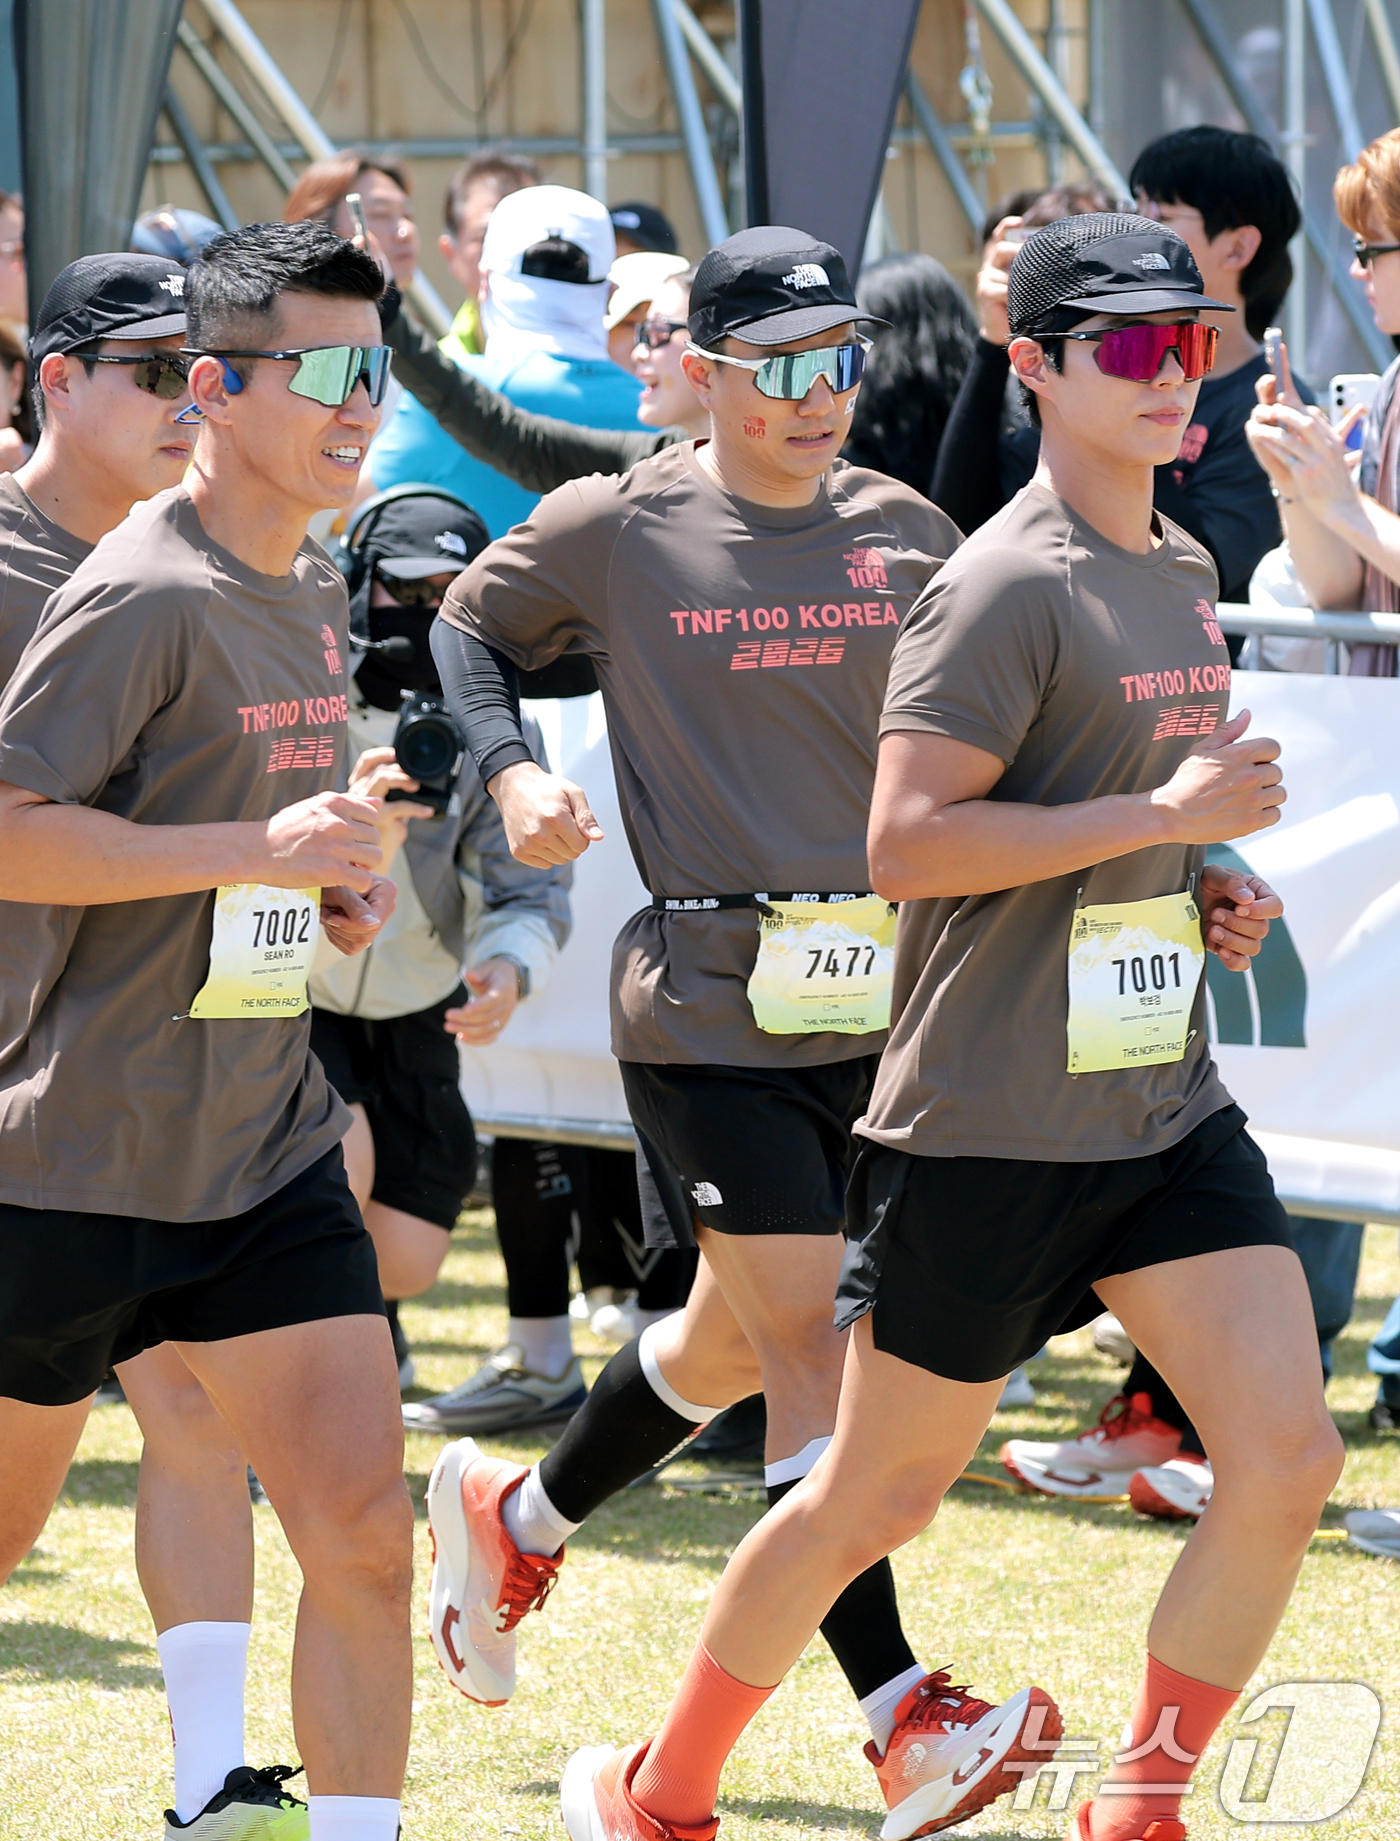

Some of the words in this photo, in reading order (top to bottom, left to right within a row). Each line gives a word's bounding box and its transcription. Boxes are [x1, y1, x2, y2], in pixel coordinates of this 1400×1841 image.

[792, 264, 813, 274] THE
[782, 270, 816, 286] NORTH
[794, 279, 817, 290] FACE
[846, 567, 888, 588] 100
[670, 606, 789, 635] TNF100
[799, 602, 899, 628] KOREA
[730, 637, 846, 671] 2026
[1119, 669, 1185, 703] TNF100
[237, 700, 300, 734] TNF100
[791, 893, 820, 903] NEO
[253, 906, 310, 948] 7002
[765, 919, 783, 930] 100
[264, 950, 283, 961] SEAN
[284, 949, 295, 960] RO
[805, 945, 876, 979] 7477
[1112, 952, 1181, 995] 7001
[241, 999, 255, 1008] THE
[256, 998, 280, 1008] NORTH
[1139, 994, 1161, 1007] 박보검
[819, 1018, 848, 1026] NORTH
[849, 1017, 867, 1026] FACE
[1122, 1047, 1138, 1058] THE
[1139, 1044, 1166, 1056] NORTH
[1167, 1041, 1184, 1052] FACE
